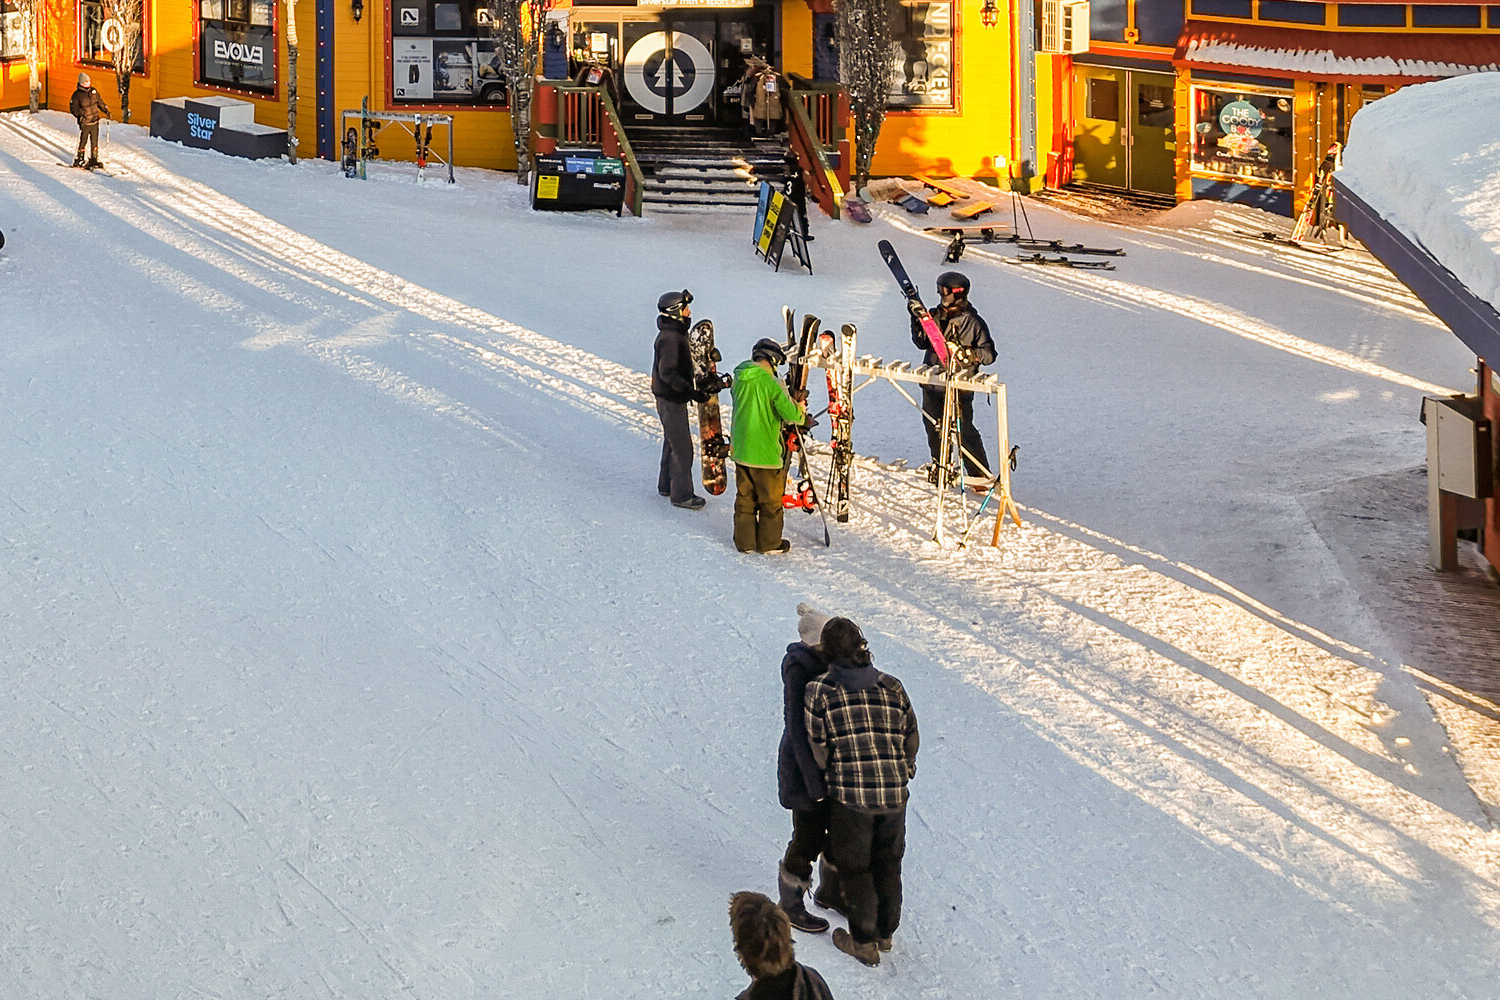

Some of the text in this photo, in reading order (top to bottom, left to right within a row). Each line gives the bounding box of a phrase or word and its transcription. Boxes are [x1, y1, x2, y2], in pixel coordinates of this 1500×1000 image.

[214, 40, 264, 65] EVOLVE
[1231, 107, 1250, 118] THE
[187, 112, 217, 130] Silver
[190, 125, 213, 140] Star
